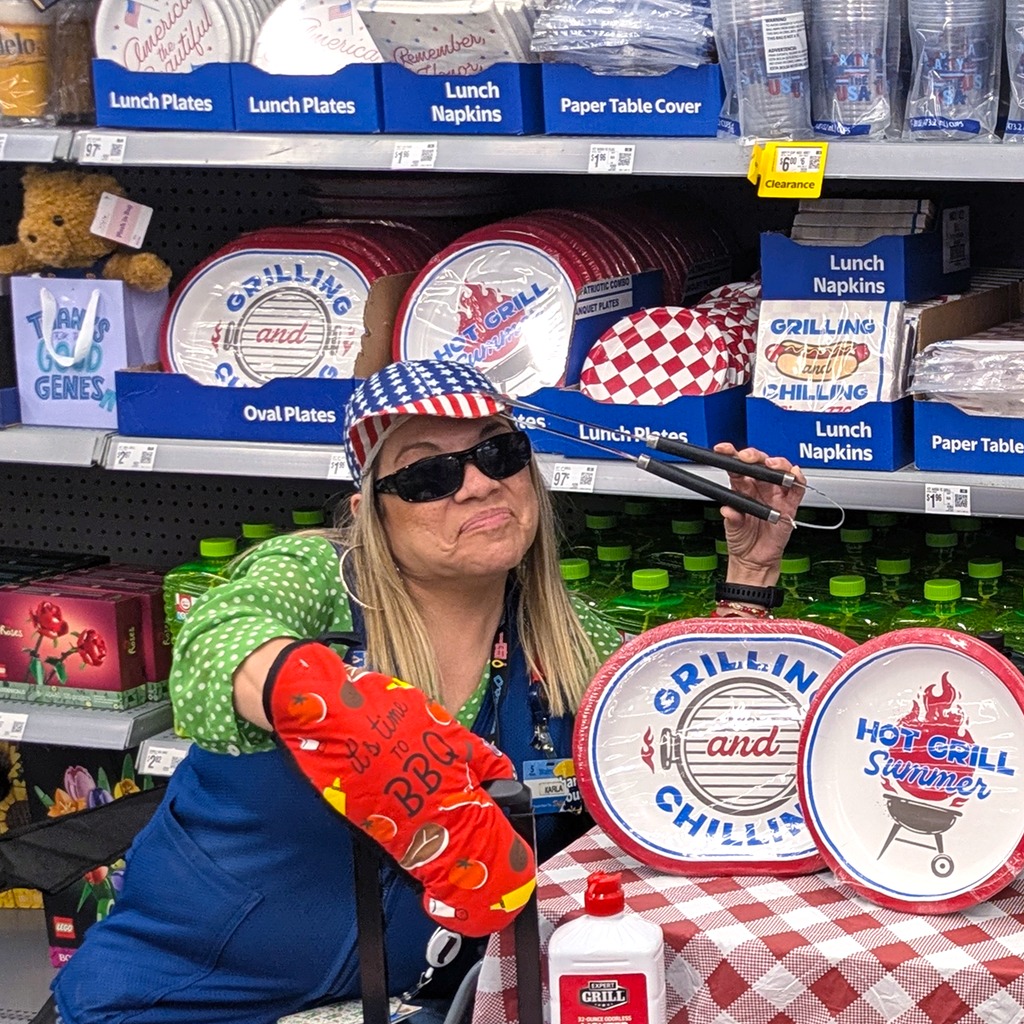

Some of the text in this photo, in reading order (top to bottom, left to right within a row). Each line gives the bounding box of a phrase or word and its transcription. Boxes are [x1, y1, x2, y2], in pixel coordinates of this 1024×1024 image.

[393, 34, 486, 65] Remember,
[445, 82, 500, 99] Lunch
[110, 91, 213, 112] Lunch Plates
[249, 97, 355, 114] Lunch Plates
[560, 98, 702, 116] Paper Table Cover
[431, 105, 502, 125] Napkins
[765, 178, 815, 190] Clearance
[830, 254, 884, 272] Lunch
[226, 263, 353, 317] GRILLING
[610, 278, 630, 290] COMBO
[813, 277, 885, 296] Napkins
[599, 298, 619, 312] PLATES
[433, 282, 549, 361] HOT GRILL
[770, 318, 875, 336] GRILLING
[255, 322, 309, 345] and
[801, 361, 832, 375] and
[34, 375, 105, 401] GENES
[762, 383, 868, 401] CHILLING
[243, 404, 336, 424] Oval Plates
[579, 424, 631, 443] Lunch
[815, 421, 872, 438] Lunch
[799, 442, 873, 463] Napkins
[932, 435, 977, 453] Paper
[980, 437, 1024, 454] Table
[345, 701, 408, 775] it's time
[707, 725, 781, 757] and
[856, 718, 1015, 776] HOT GRILL
[391, 740, 409, 759] TO
[383, 731, 460, 818] BBQ
[864, 750, 991, 800] Summer
[56, 923, 73, 932] LEGO
[582, 991, 625, 1003] GRILL
